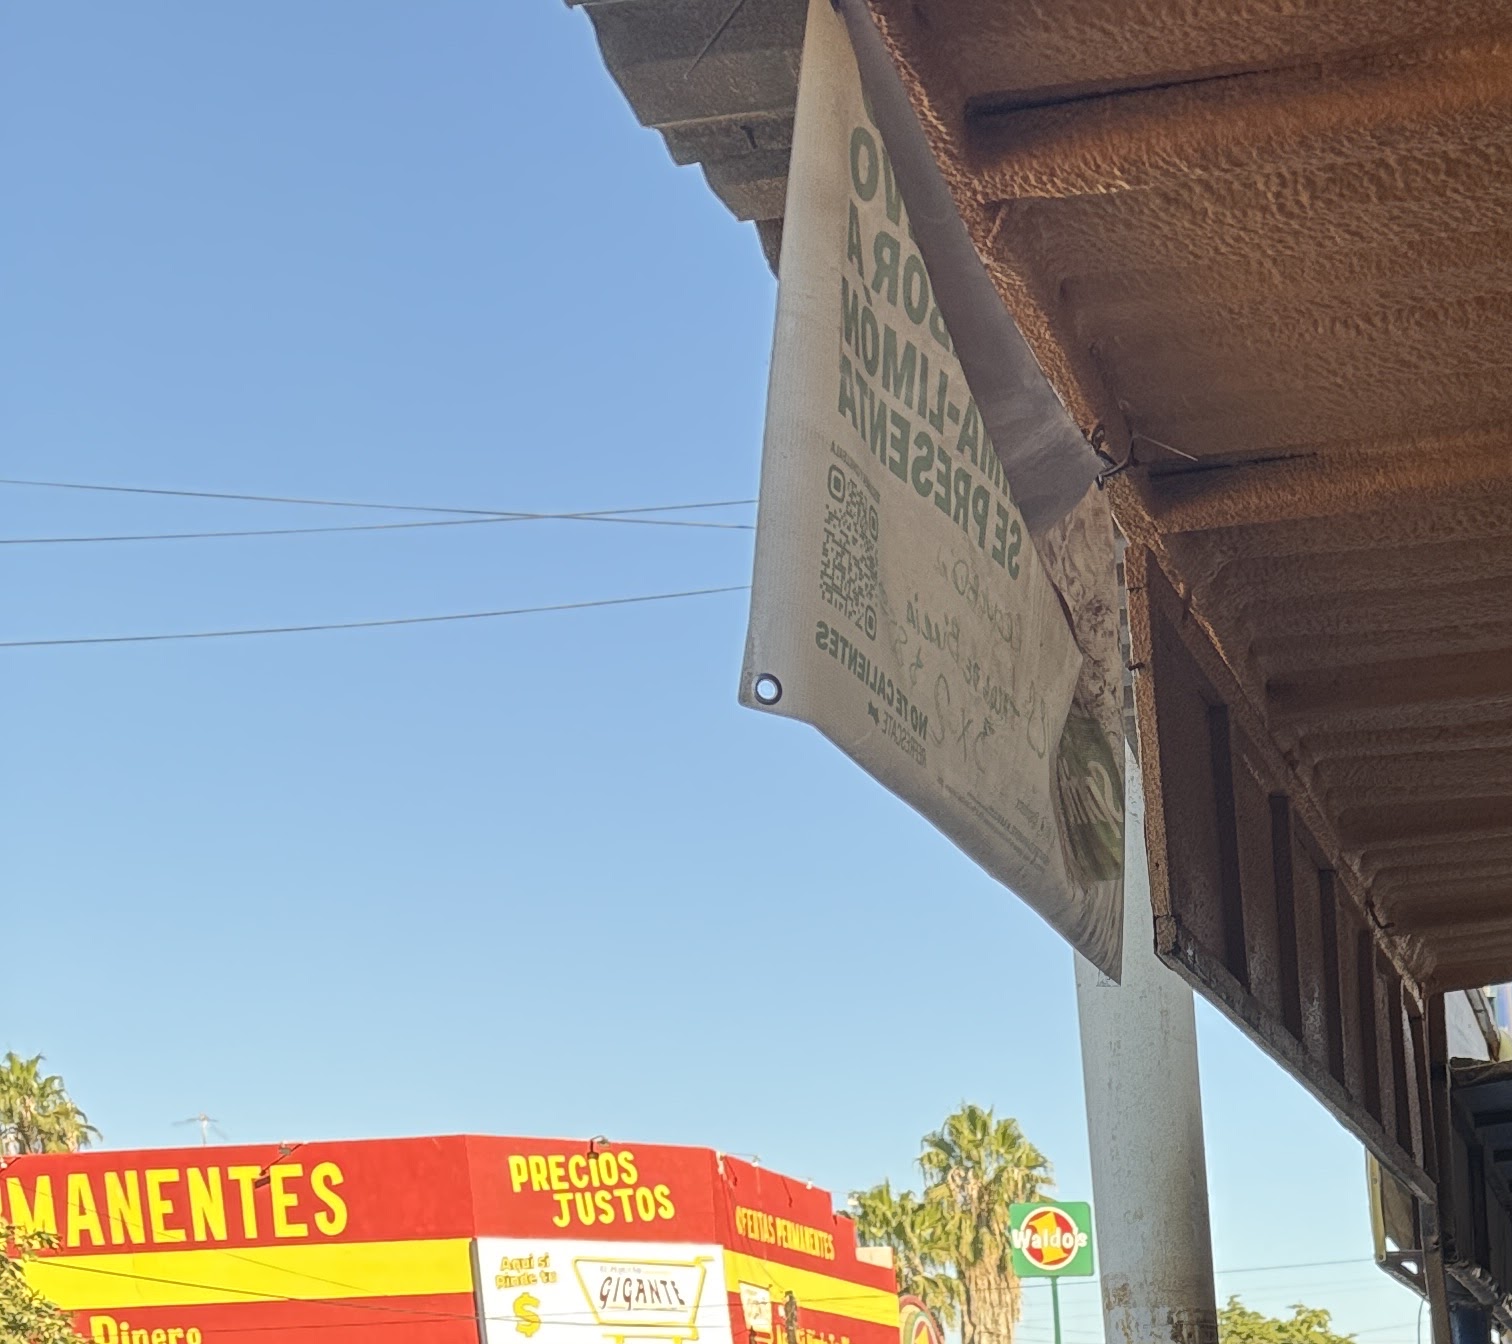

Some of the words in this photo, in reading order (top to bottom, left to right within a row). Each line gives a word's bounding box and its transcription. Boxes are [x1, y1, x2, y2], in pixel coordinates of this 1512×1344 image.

[508, 1151, 638, 1193] PRECIOS
[0, 1160, 349, 1252] MANENTES
[552, 1184, 675, 1228] JUSTOS
[1011, 1225, 1089, 1249] Waldo's
[599, 1276, 687, 1311] GIGANTE
